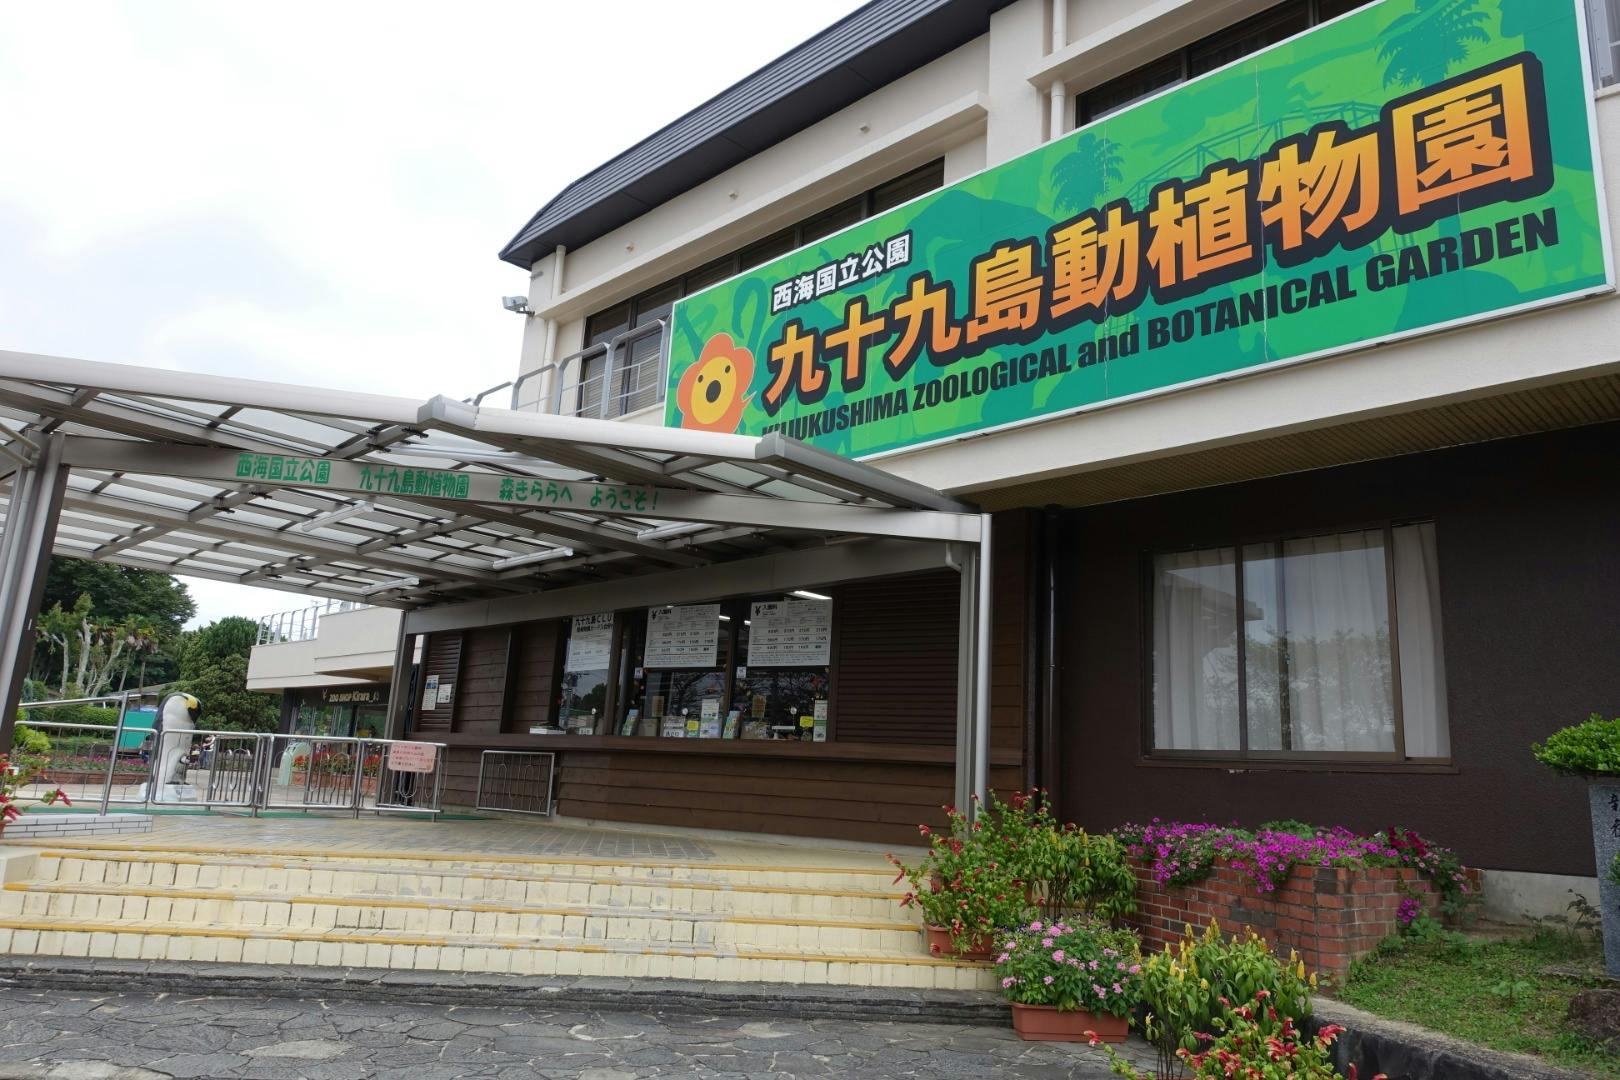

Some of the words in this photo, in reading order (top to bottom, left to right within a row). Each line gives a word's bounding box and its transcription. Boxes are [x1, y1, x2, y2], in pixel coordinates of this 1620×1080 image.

[762, 60, 1540, 407] 九十九島動植物園
[772, 233, 911, 313] 西海国立公園
[912, 342, 1072, 412] ZOOLOGICAL
[1078, 321, 1141, 369] and
[1147, 263, 1357, 350] BOTANICAL
[1365, 208, 1560, 293] GARDEN
[235, 453, 332, 485] 西海国立公園
[358, 467, 470, 499] 九十九島動植物園
[498, 477, 573, 504] 森きららへ
